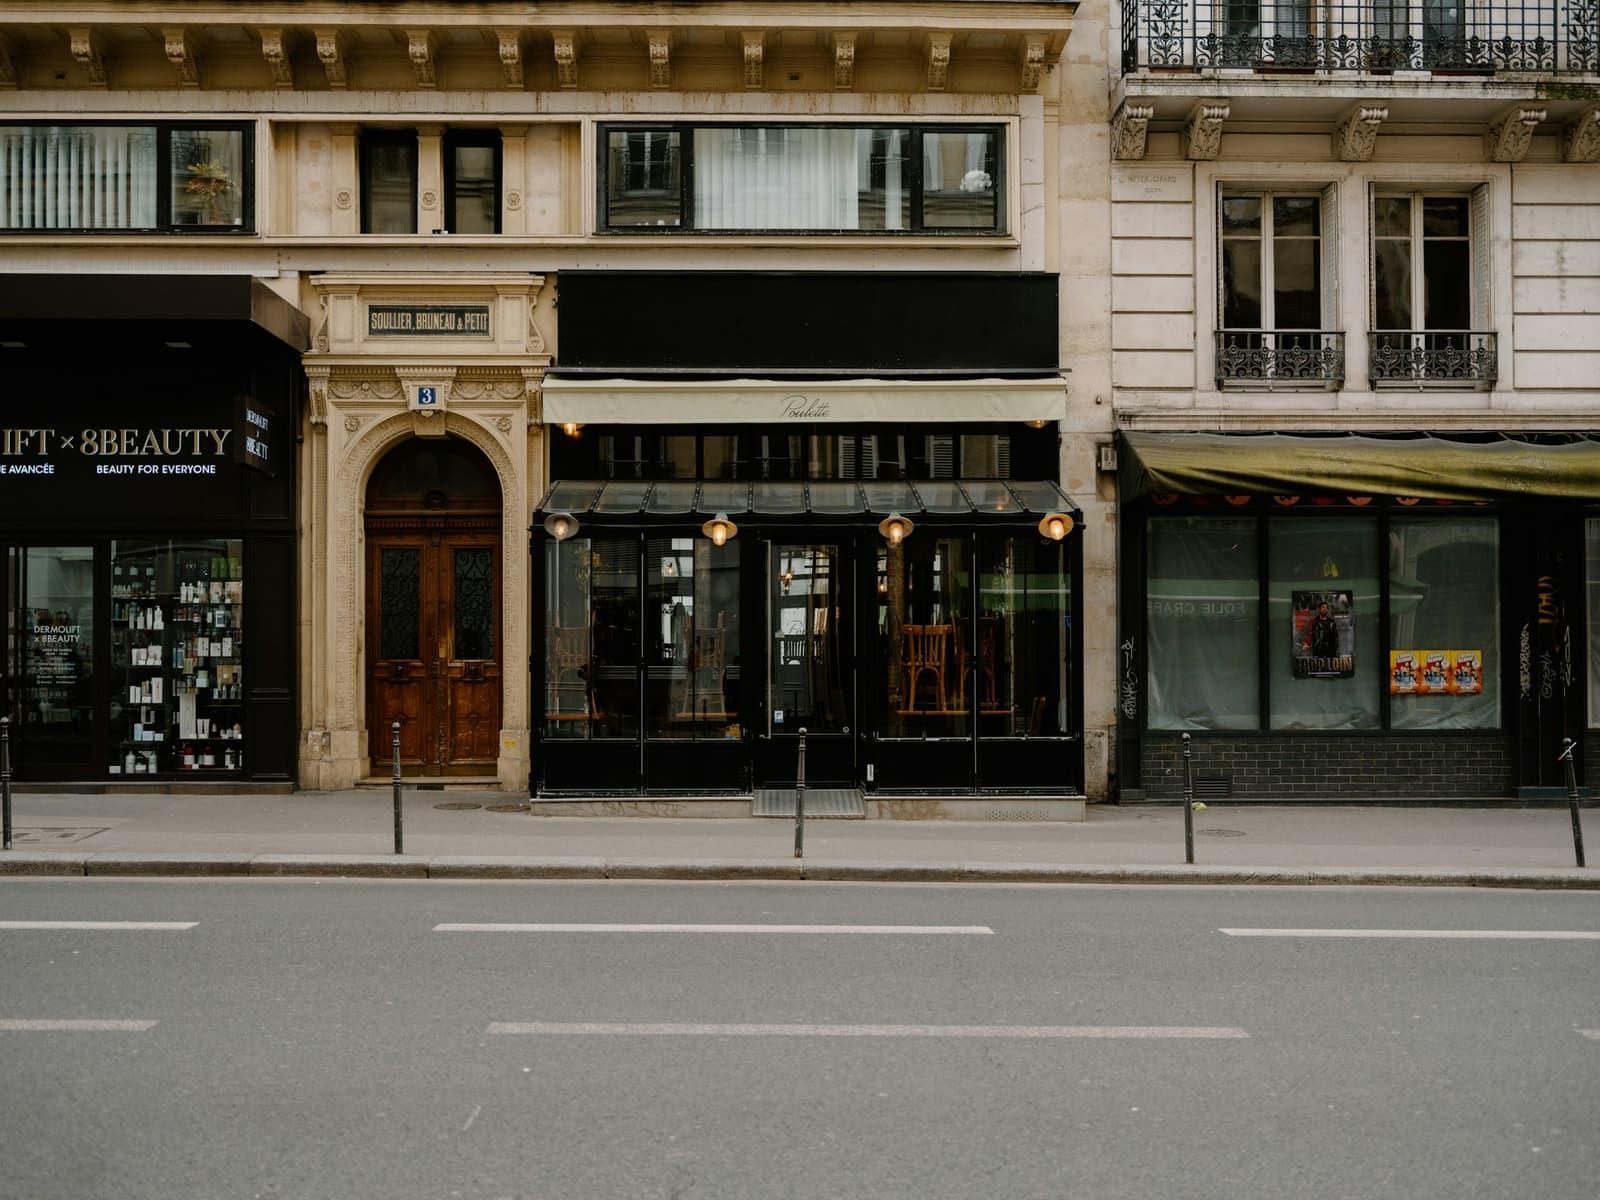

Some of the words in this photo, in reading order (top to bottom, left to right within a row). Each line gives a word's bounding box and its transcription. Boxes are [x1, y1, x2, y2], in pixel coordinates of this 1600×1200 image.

[416, 312, 455, 330] BRUNEAU
[457, 317, 463, 330] &
[464, 313, 488, 330] PETIT
[422, 388, 432, 404] 3
[780, 394, 830, 418] Poulette
[80, 428, 232, 456] 8BEAUTY
[8, 462, 55, 474] AVANCÉE
[96, 464, 135, 475] BEAUTY
[138, 464, 159, 475] FOR
[162, 464, 216, 475] EVERYONE
[34, 625, 80, 634] DERMOLIFT
